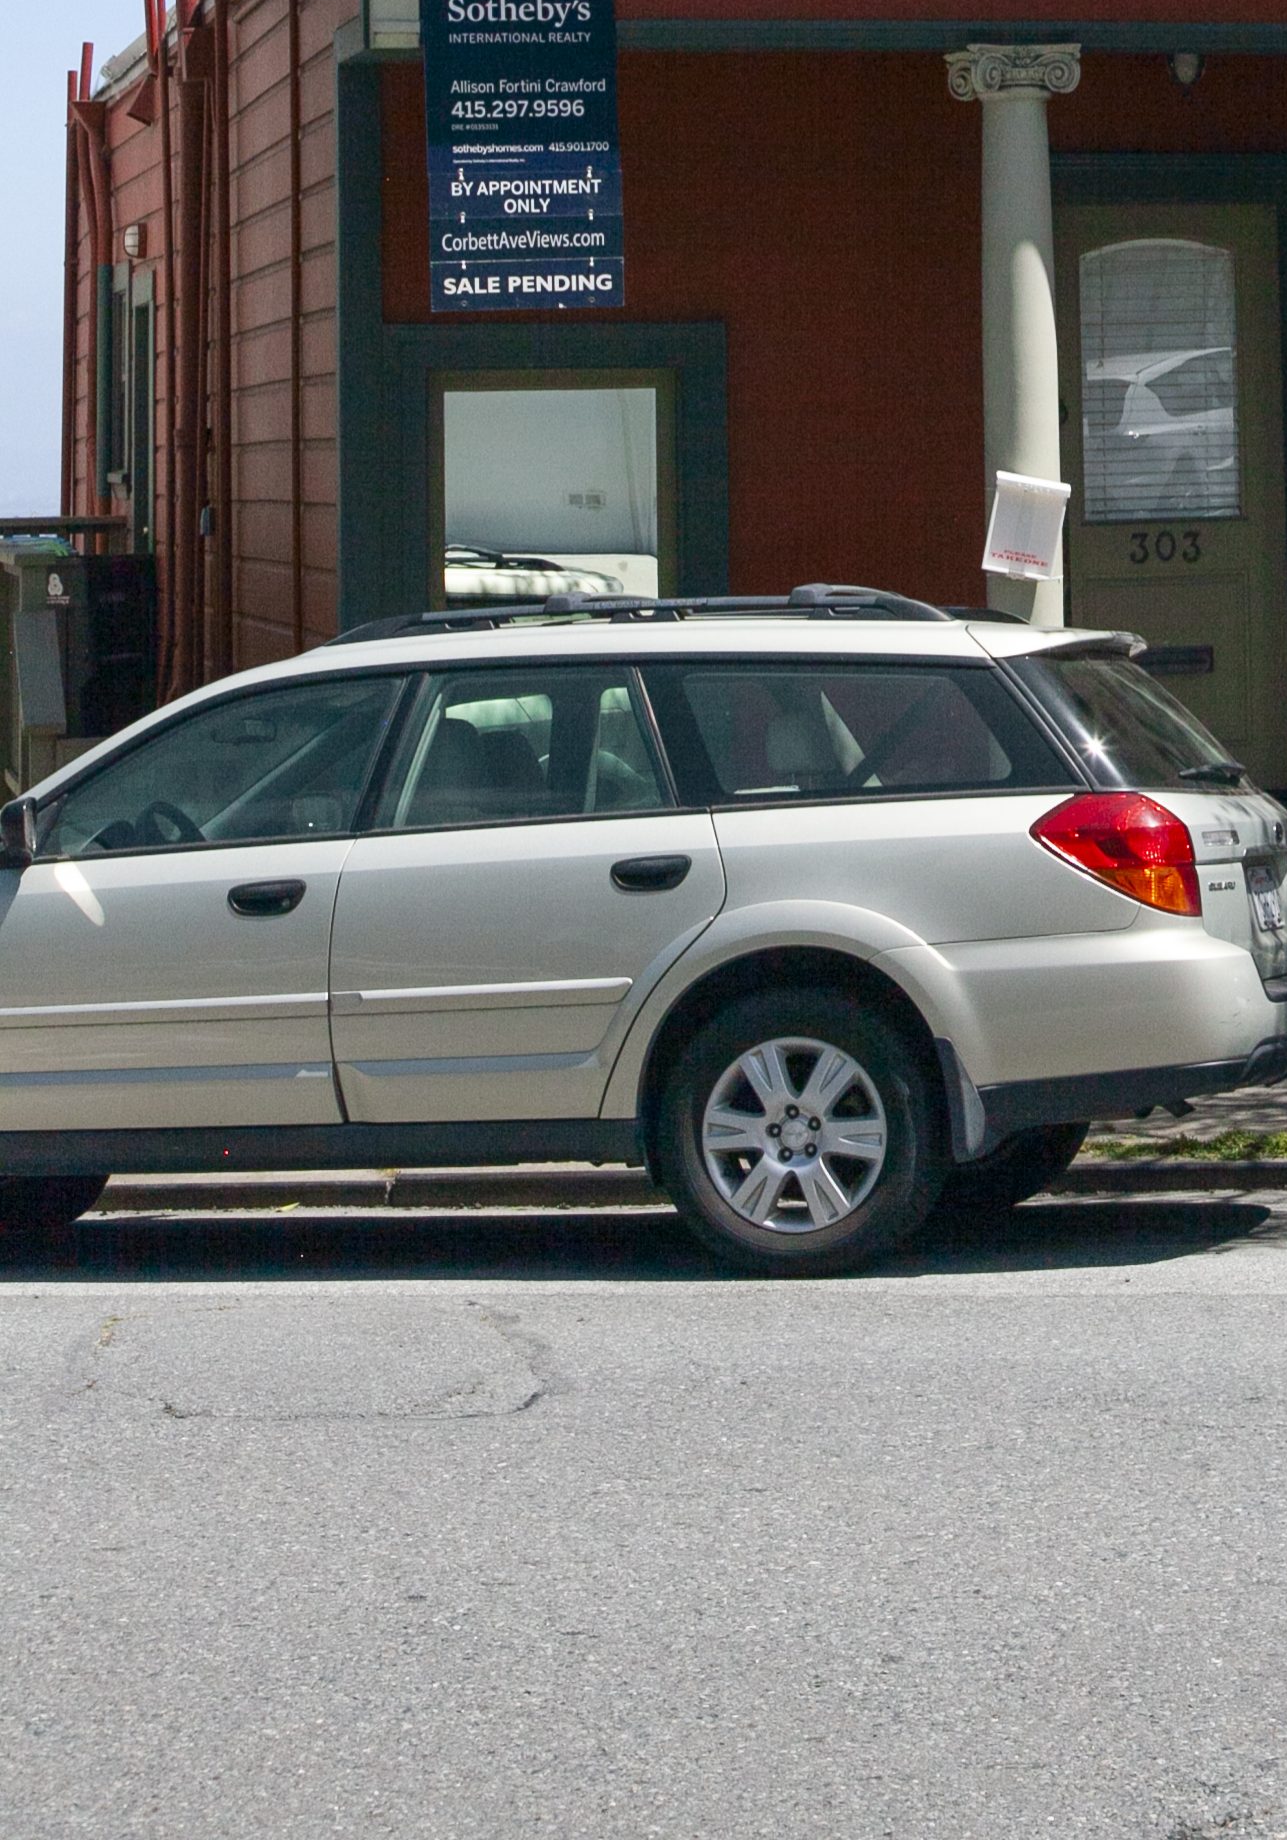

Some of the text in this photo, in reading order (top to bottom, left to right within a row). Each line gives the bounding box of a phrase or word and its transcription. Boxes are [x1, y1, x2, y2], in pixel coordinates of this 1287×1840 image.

[448, 31, 592, 44] INTERNATIONAL REALTY
[450, 78, 607, 94] Allison Fortini Crawford
[451, 99, 585, 118] 415.297.9596
[452, 141, 610, 155] sothebyshomes.com 415.901.1700
[451, 179, 602, 197] BY APPOINTMENT
[503, 198, 551, 214] ONLY
[441, 230, 605, 252] CorbettAveViews.com
[443, 273, 613, 295] SALE PENDING
[1129, 531, 1201, 564] 303
